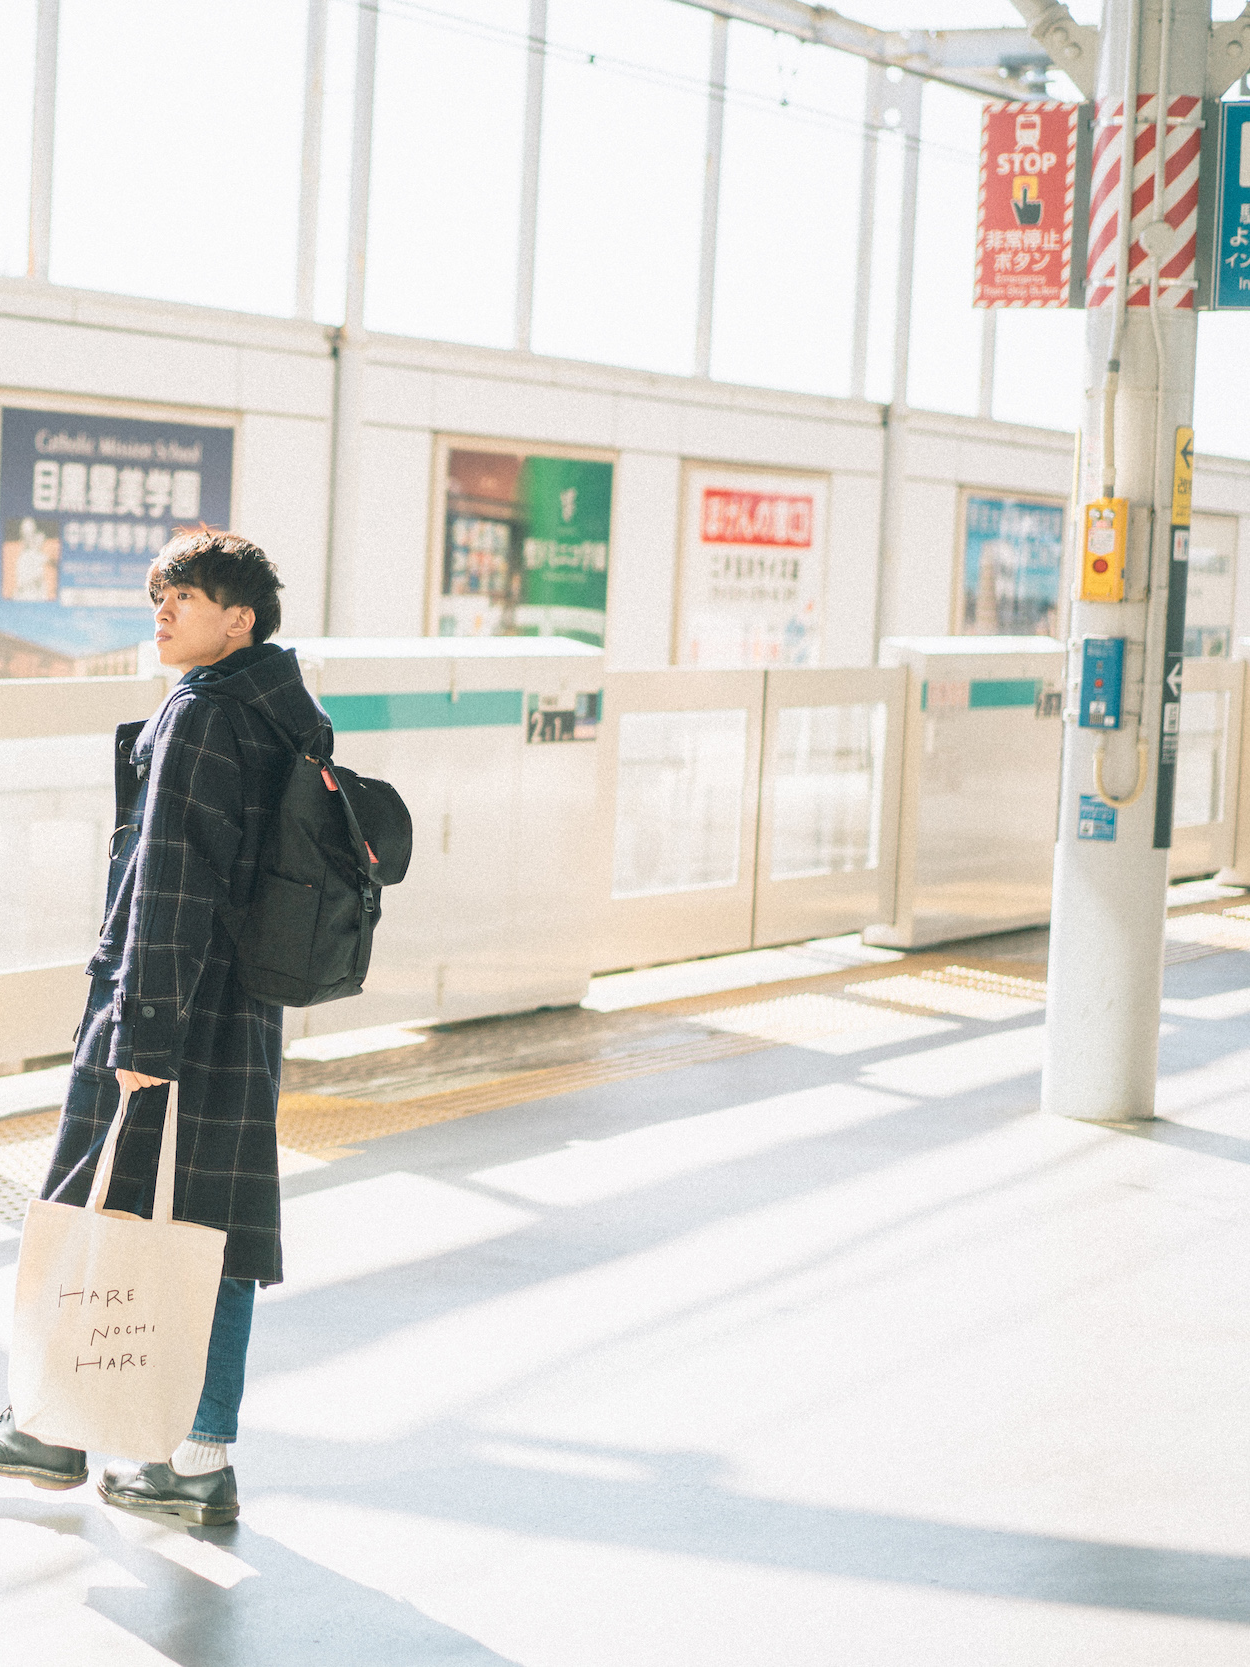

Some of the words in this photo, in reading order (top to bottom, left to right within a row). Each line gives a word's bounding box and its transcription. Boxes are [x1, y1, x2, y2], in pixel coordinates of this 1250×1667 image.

[997, 152, 1057, 176] STOP
[984, 228, 1061, 252] 非常停止
[993, 251, 1051, 272] ボタン
[154, 439, 203, 464] School
[58, 1284, 134, 1307] HARE
[91, 1324, 155, 1346] NOCHI
